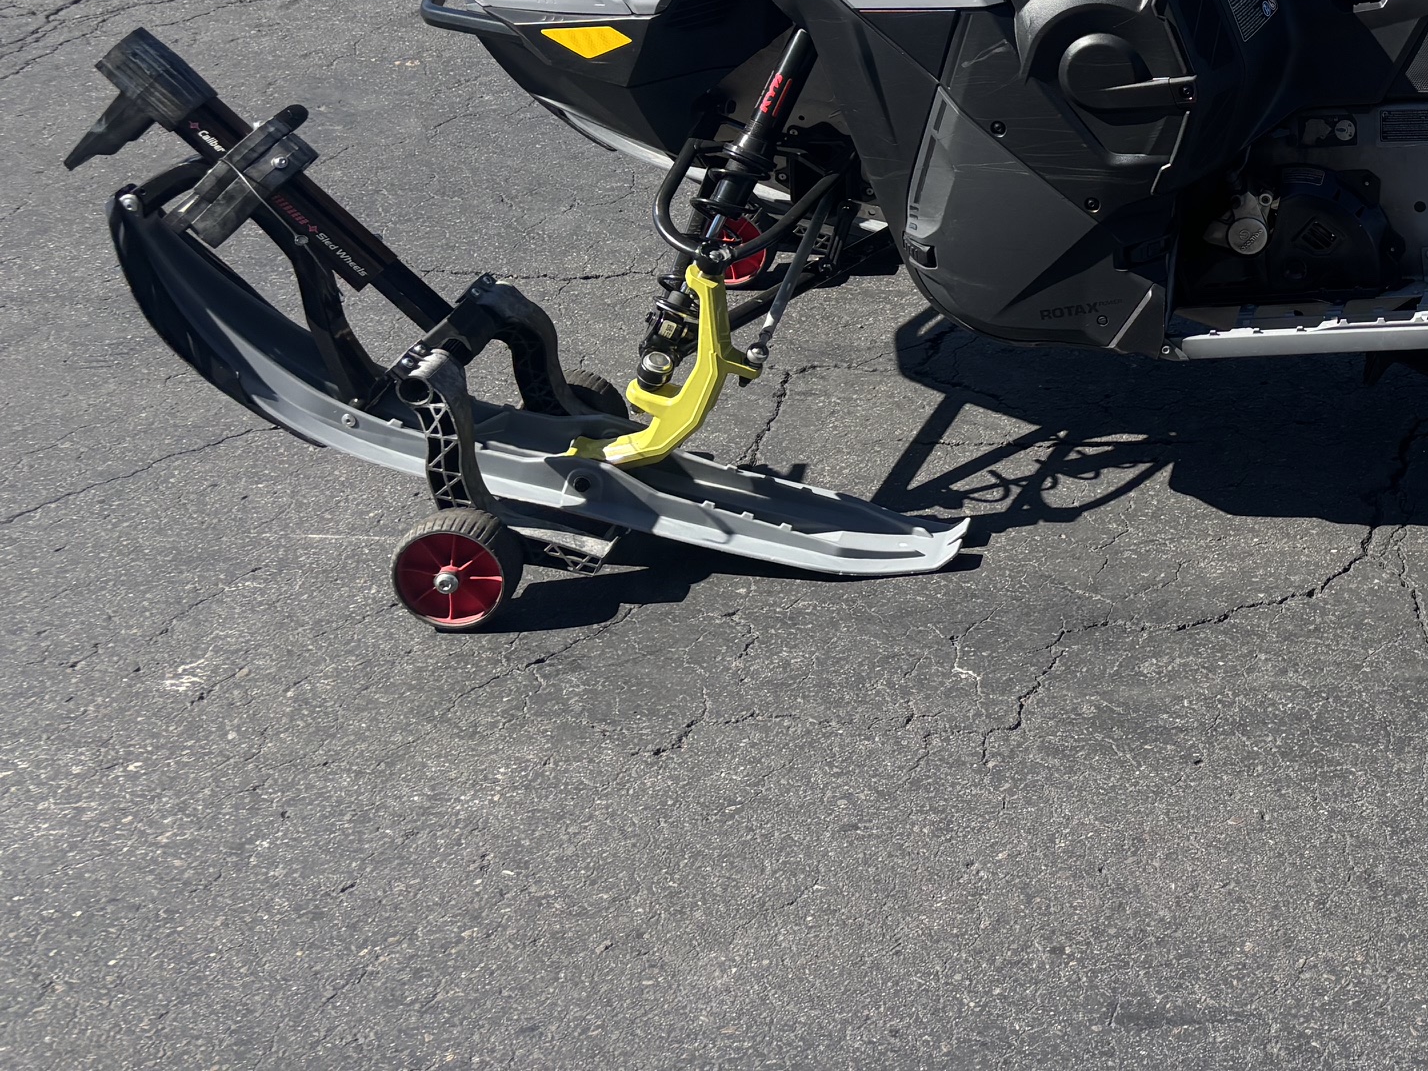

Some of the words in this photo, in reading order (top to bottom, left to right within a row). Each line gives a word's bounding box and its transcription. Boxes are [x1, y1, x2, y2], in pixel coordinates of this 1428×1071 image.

[198, 129, 227, 153] Caliber
[316, 232, 338, 250] Sled
[335, 247, 368, 277] Wheels
[1039, 302, 1099, 320] ROTAX
